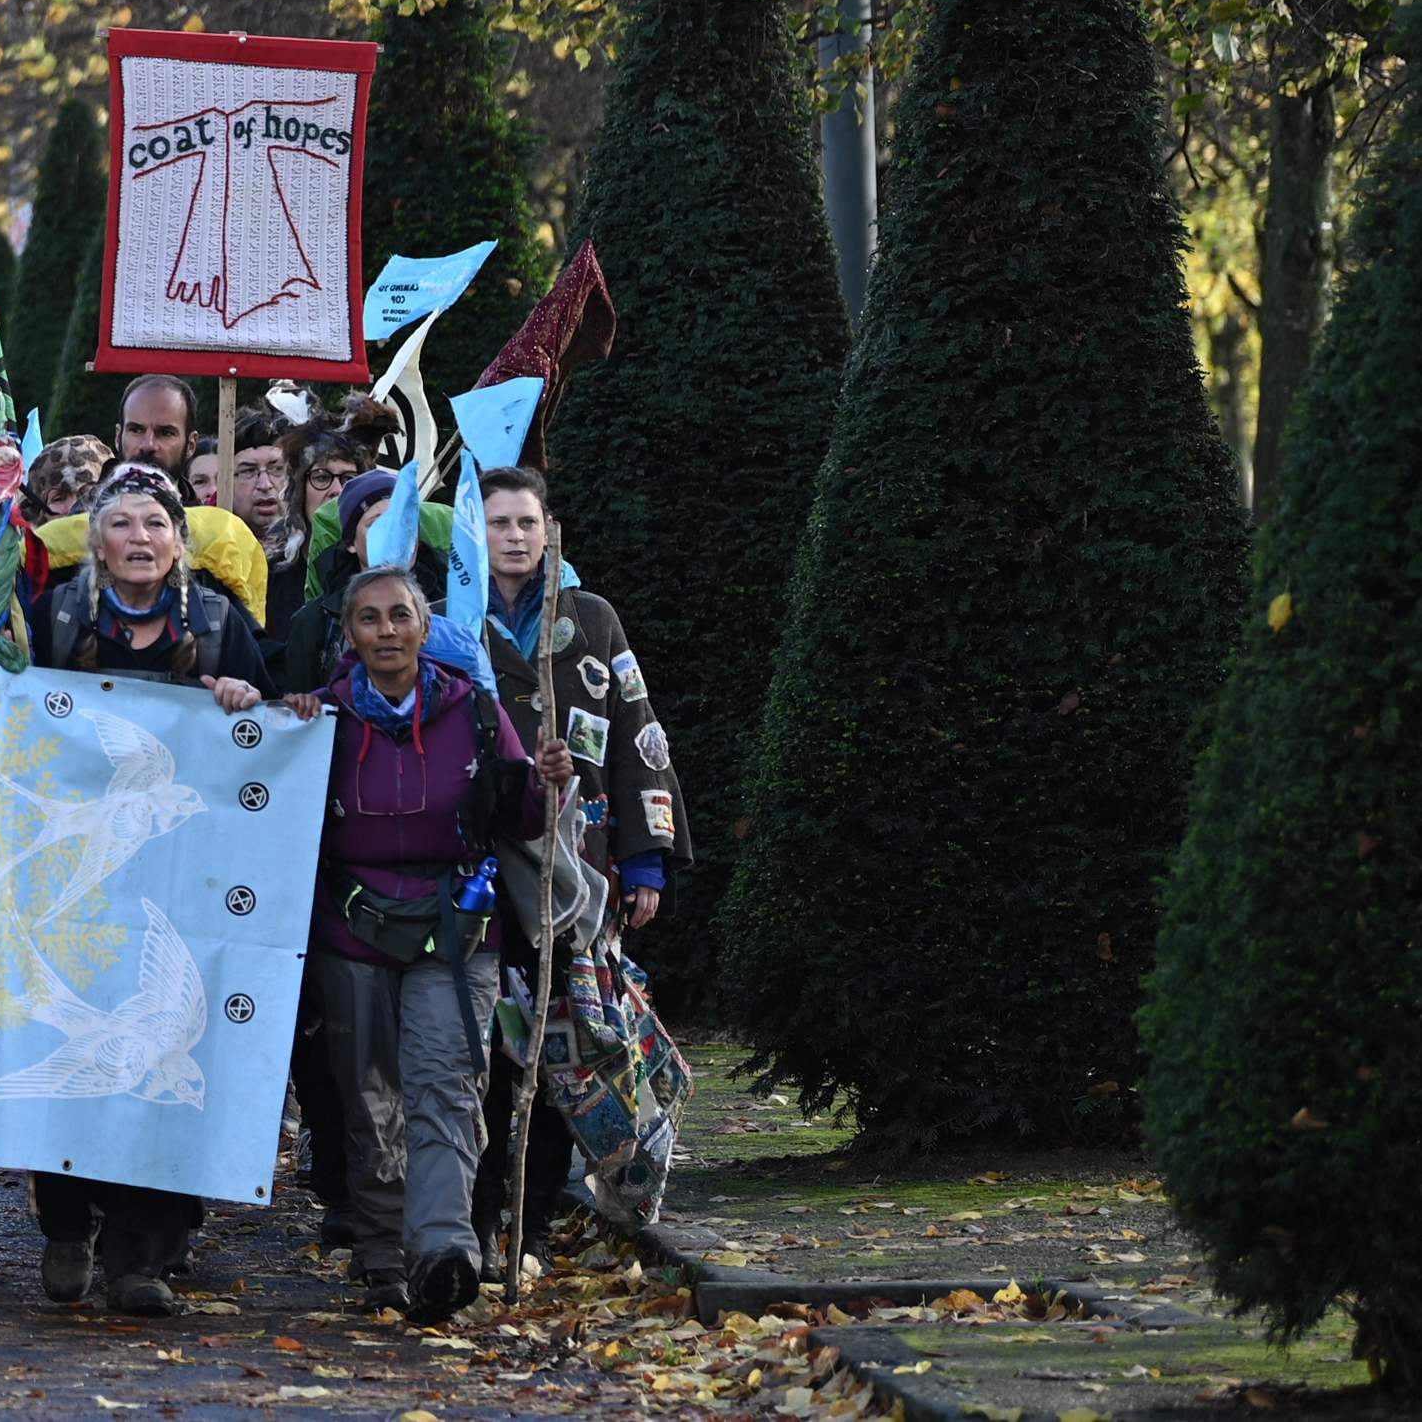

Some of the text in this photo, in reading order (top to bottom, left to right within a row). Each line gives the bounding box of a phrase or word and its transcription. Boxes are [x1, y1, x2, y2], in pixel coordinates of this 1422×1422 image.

[128, 105, 351, 169] coat of hopes
[457, 571, 472, 587] TO
